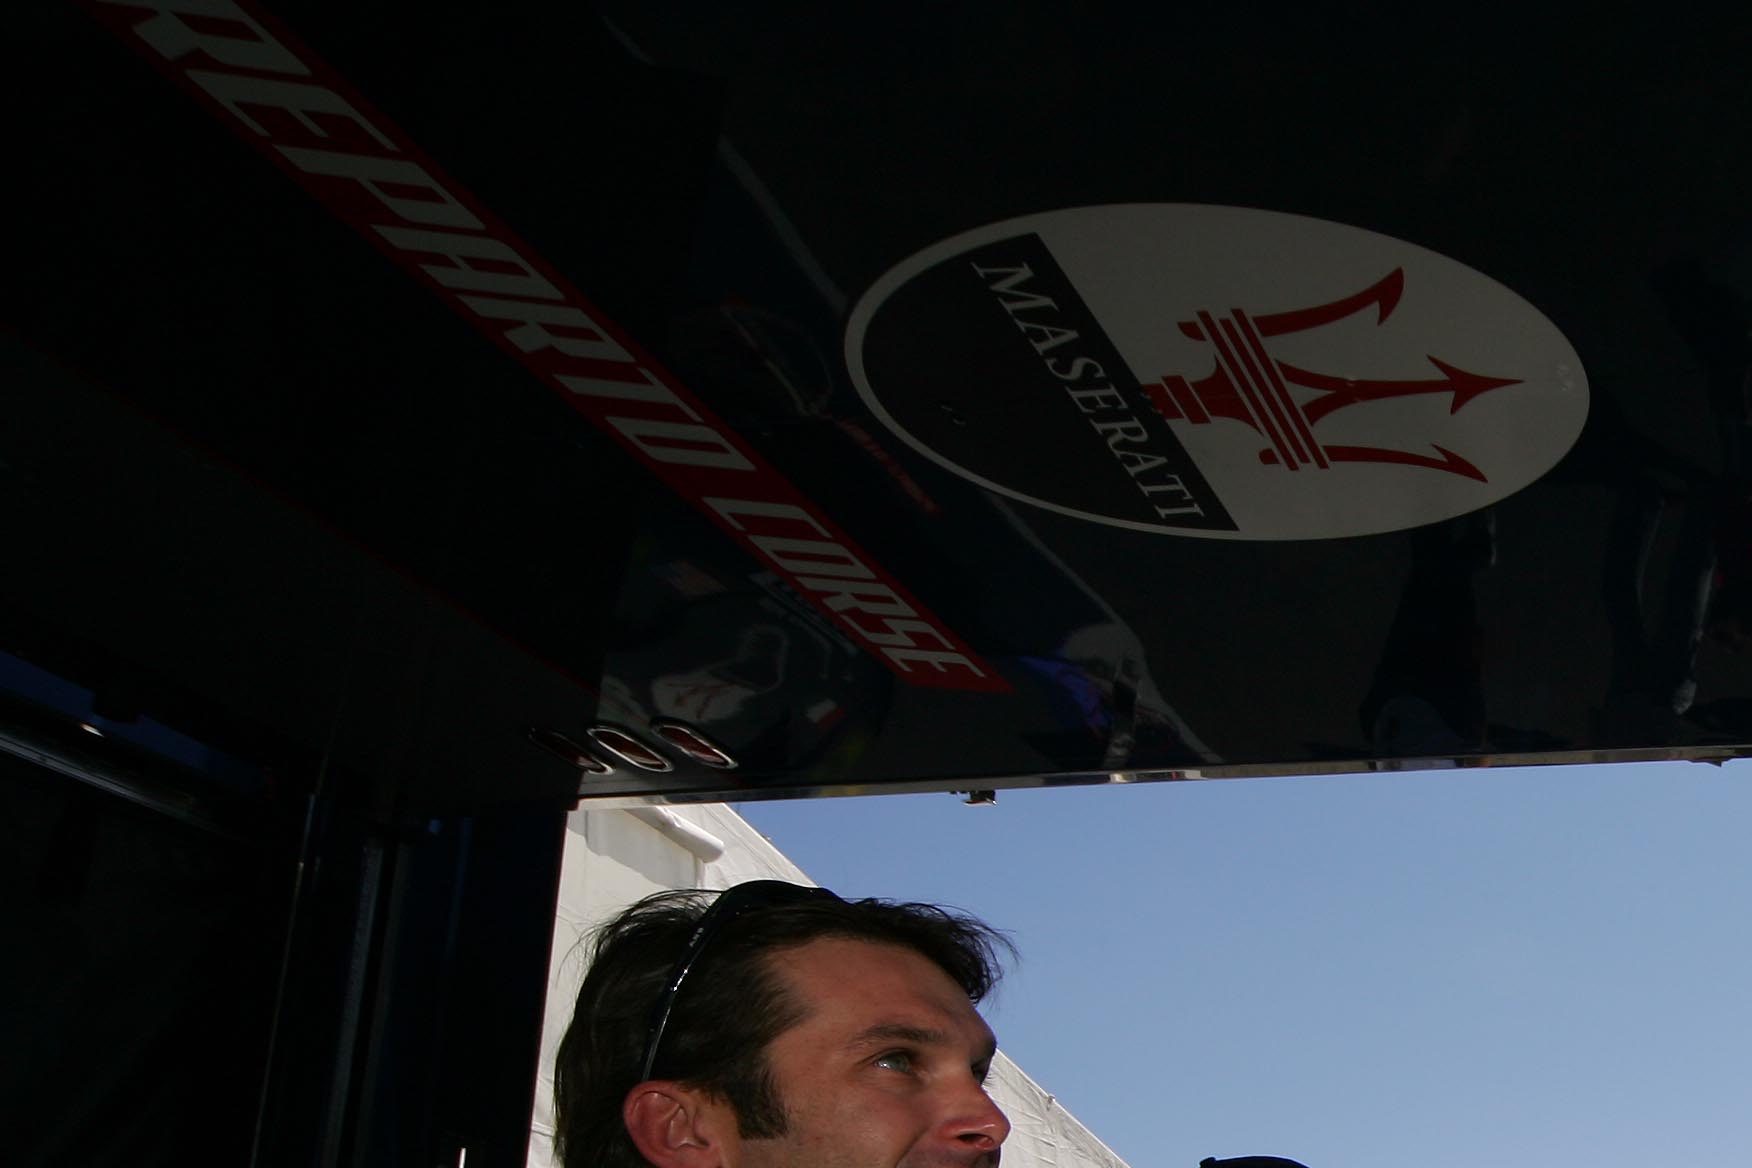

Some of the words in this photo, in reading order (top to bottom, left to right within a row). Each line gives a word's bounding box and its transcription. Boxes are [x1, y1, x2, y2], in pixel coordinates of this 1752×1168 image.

[96, 0, 756, 473] REPARTO
[702, 496, 987, 681] CORSE
[971, 259, 1206, 521] MASERATI
